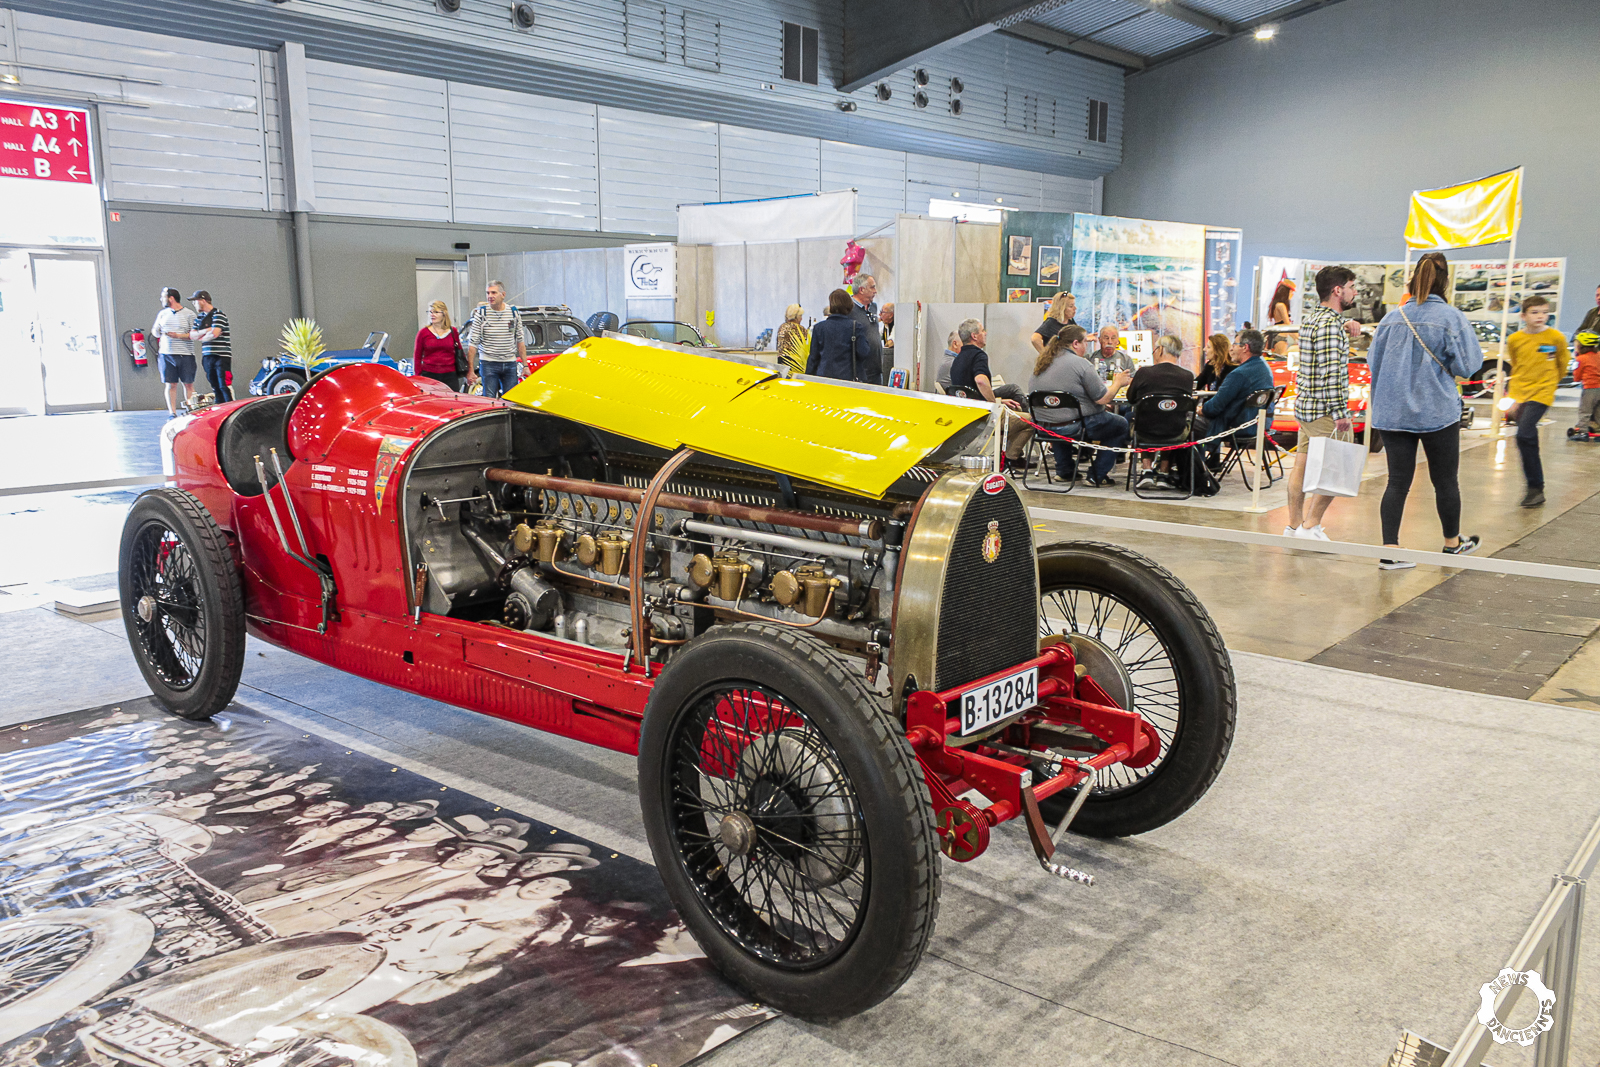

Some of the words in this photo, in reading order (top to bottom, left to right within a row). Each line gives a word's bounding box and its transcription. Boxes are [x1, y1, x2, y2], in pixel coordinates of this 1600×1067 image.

[1, 117, 24, 127] HALL
[29, 109, 59, 130] A3
[3, 142, 26, 152] HALL
[31, 133, 61, 155] A4
[1, 166, 29, 176] HALLS
[34, 157, 52, 178] B
[1523, 261, 1559, 269] FRANCE
[986, 480, 1005, 490] BUGATTI
